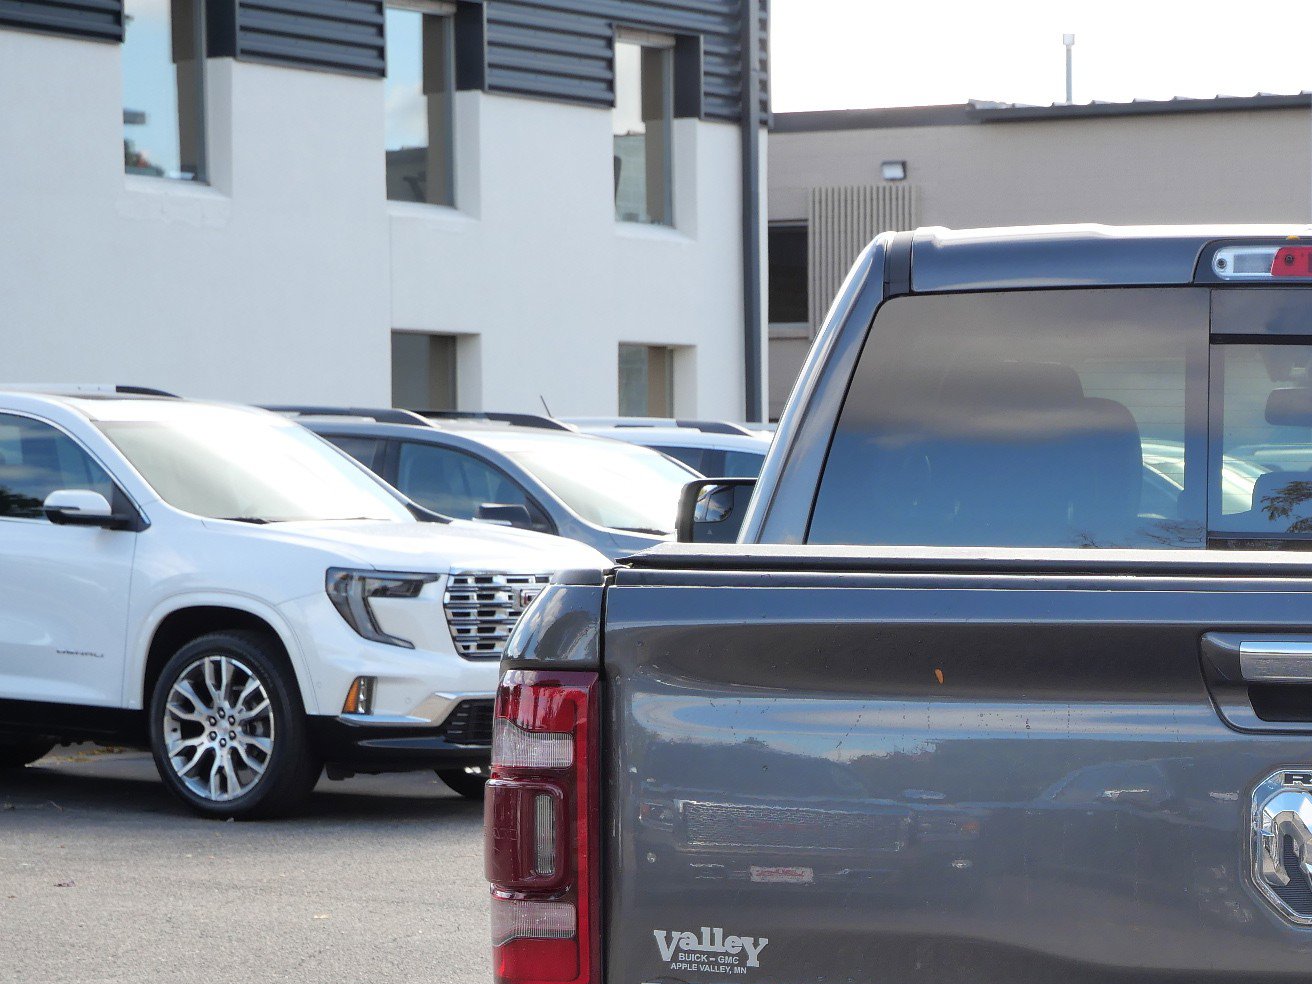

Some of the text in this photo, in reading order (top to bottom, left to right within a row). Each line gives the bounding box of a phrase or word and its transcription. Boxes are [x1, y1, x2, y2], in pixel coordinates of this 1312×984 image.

[678, 952, 708, 963] BUICK
[717, 955, 739, 965] GMC
[670, 962, 747, 975] APPLE VALLEY, MN
